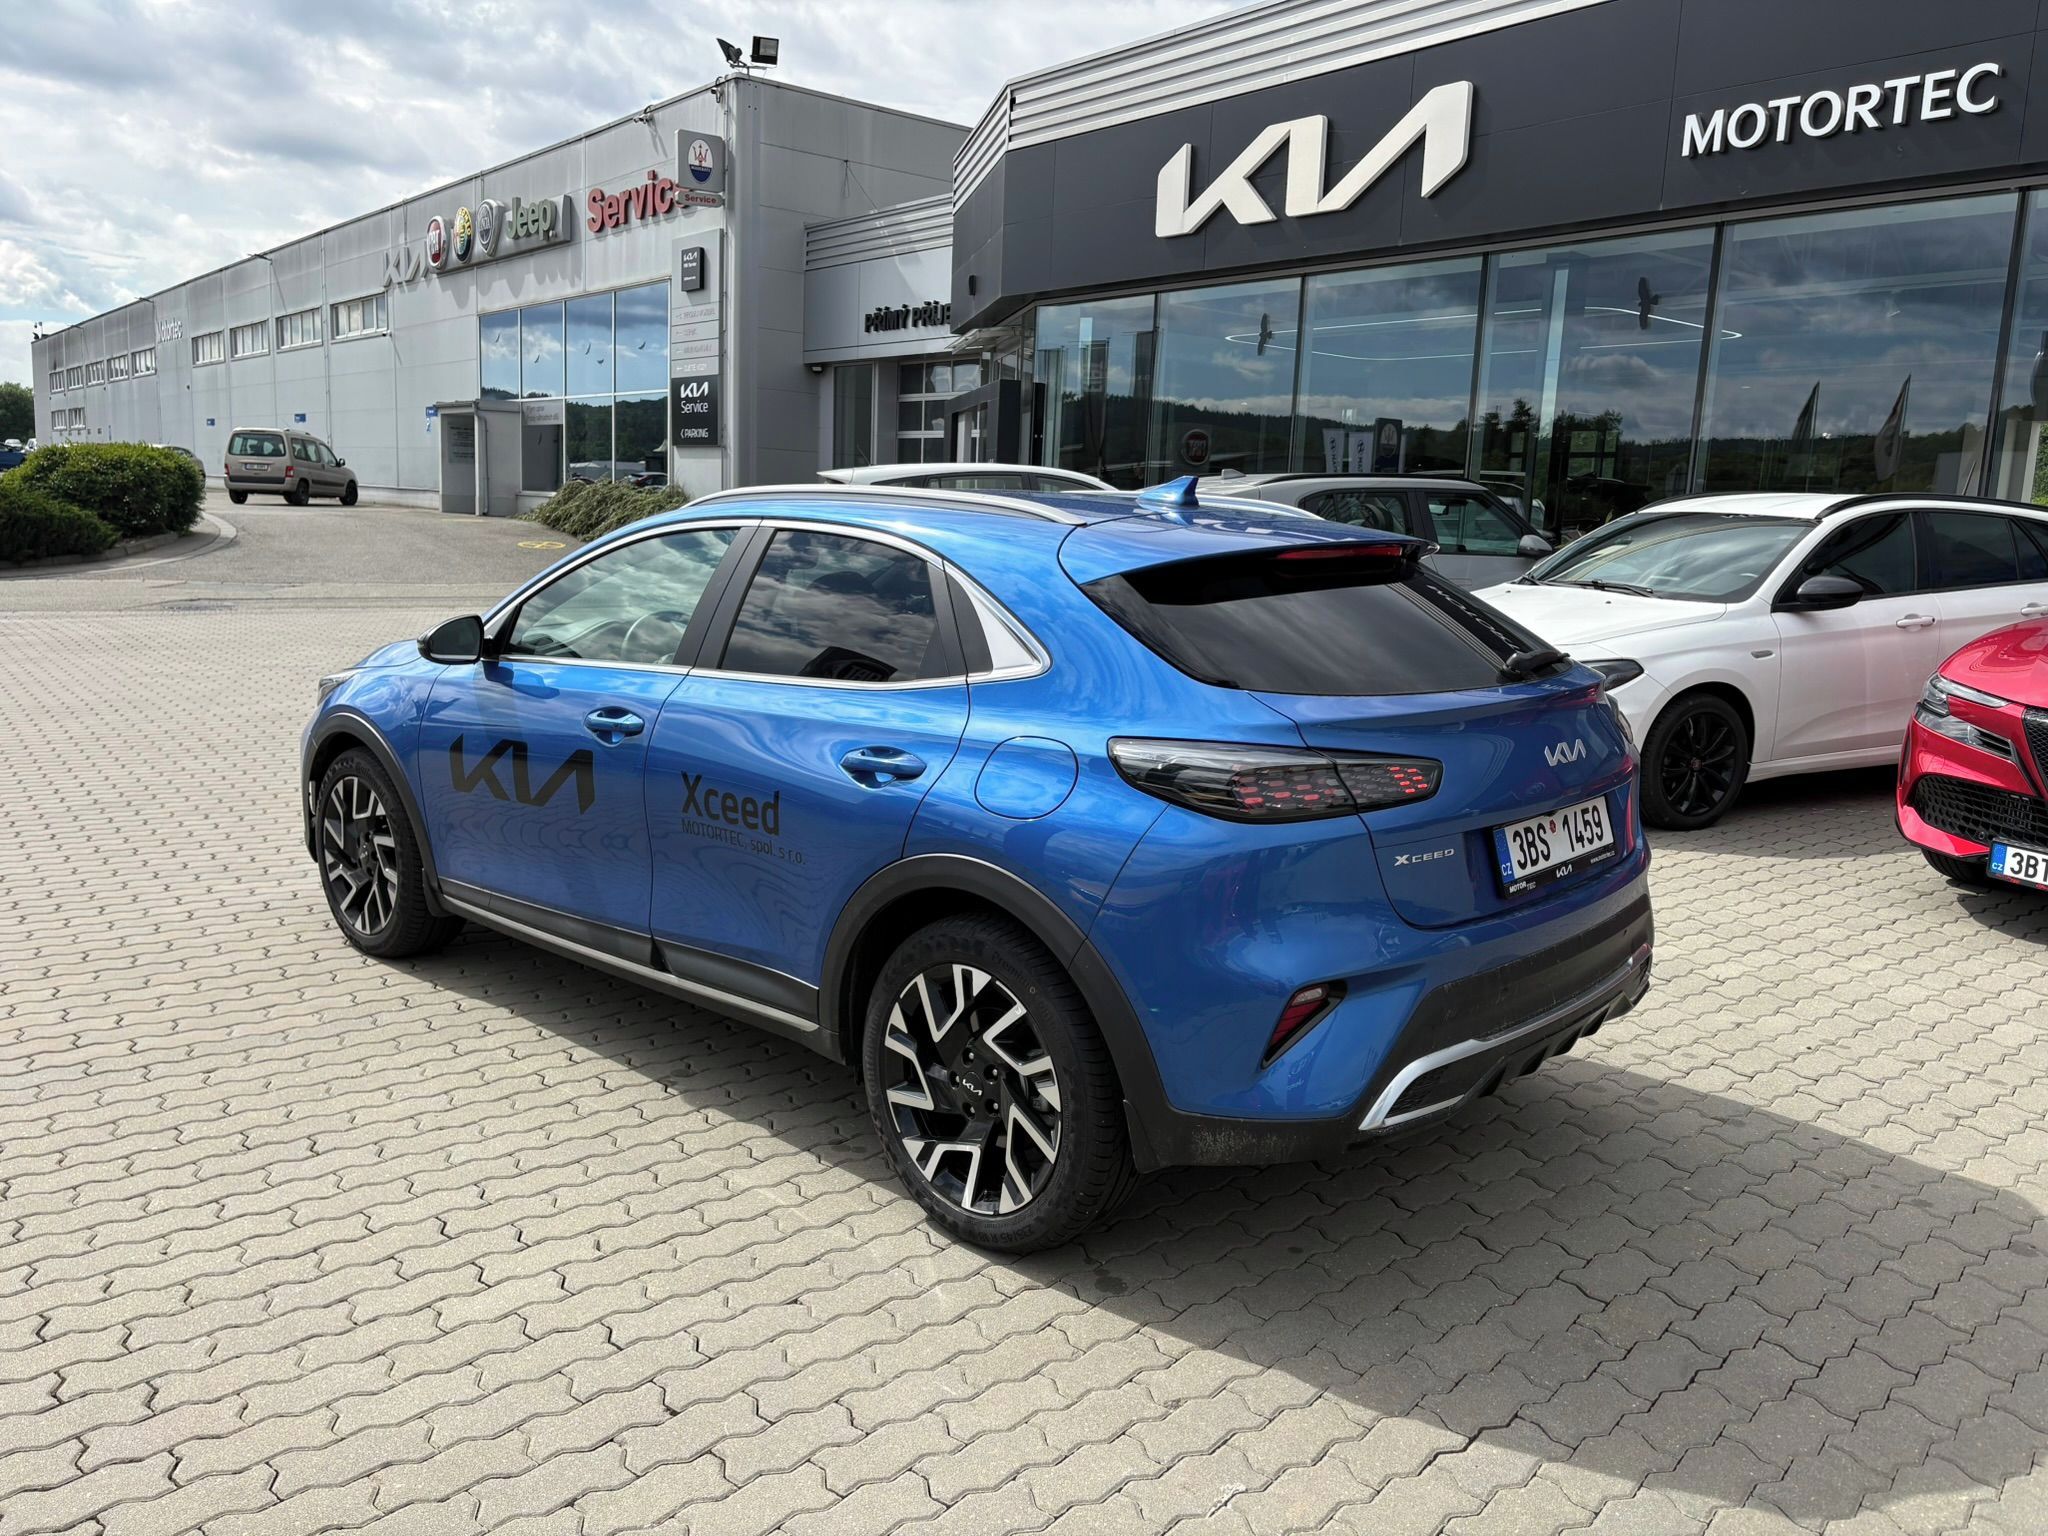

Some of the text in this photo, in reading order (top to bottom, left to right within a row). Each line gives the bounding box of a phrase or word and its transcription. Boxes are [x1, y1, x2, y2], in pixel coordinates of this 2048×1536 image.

[1681, 62, 2003, 158] MOTORTEC
[1155, 80, 1473, 238] KIA
[684, 193, 717, 205] Service
[505, 197, 557, 241] Jeep
[864, 303, 910, 333] PŘÍMÝ
[680, 381, 709, 398] KIA
[680, 400, 709, 414] Service
[684, 428, 709, 438] PARKING
[1544, 739, 1586, 767] KIA
[449, 733, 595, 815] KIA
[681, 770, 779, 836] Xceed
[1513, 805, 1604, 870] 3BS 1459
[750, 839, 776, 857] spol.
[1393, 848, 1455, 867] XCEED
[1501, 863, 1513, 876] CZ
[1556, 864, 1573, 878] KIA
[1992, 862, 2003, 871] CZ
